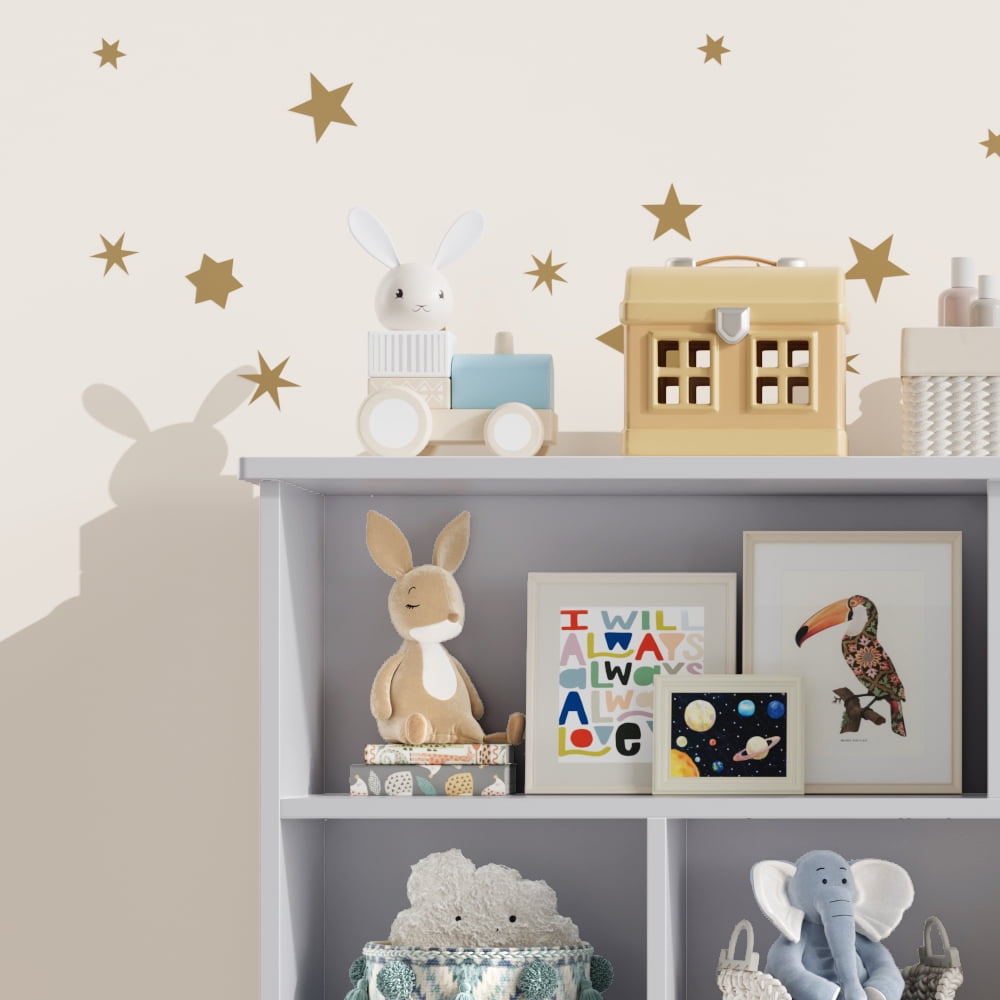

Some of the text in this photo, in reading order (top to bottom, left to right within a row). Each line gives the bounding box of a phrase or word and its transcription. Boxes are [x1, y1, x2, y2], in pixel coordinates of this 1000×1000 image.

[561, 610, 704, 631] I WILL
[560, 632, 704, 666] ALWAYS
